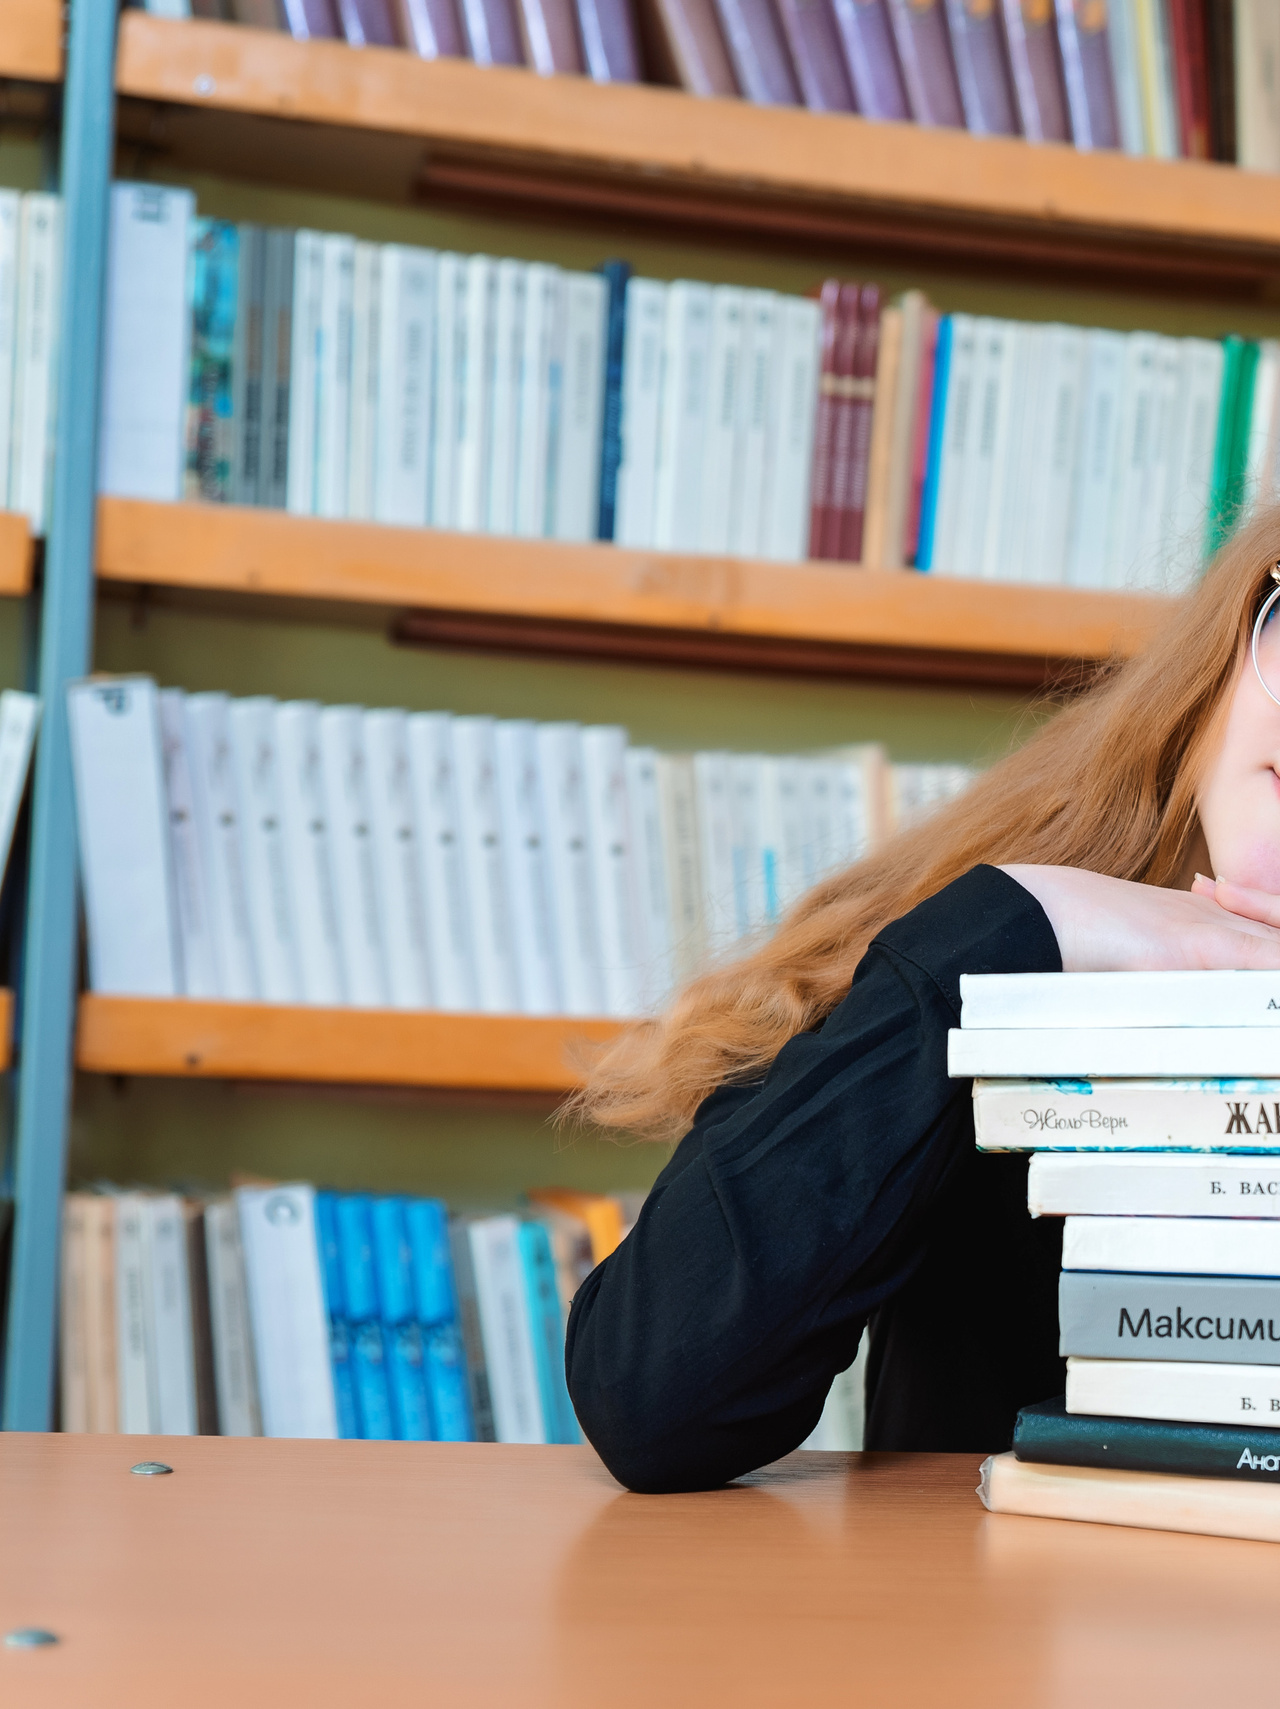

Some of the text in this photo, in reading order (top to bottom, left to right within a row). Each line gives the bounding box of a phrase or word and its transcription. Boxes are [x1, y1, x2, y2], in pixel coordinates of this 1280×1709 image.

[1022, 1108, 1129, 1135] Жюль Верн
[1210, 1181, 1226, 1195] Б.
[1241, 1397, 1257, 1411] Б.
